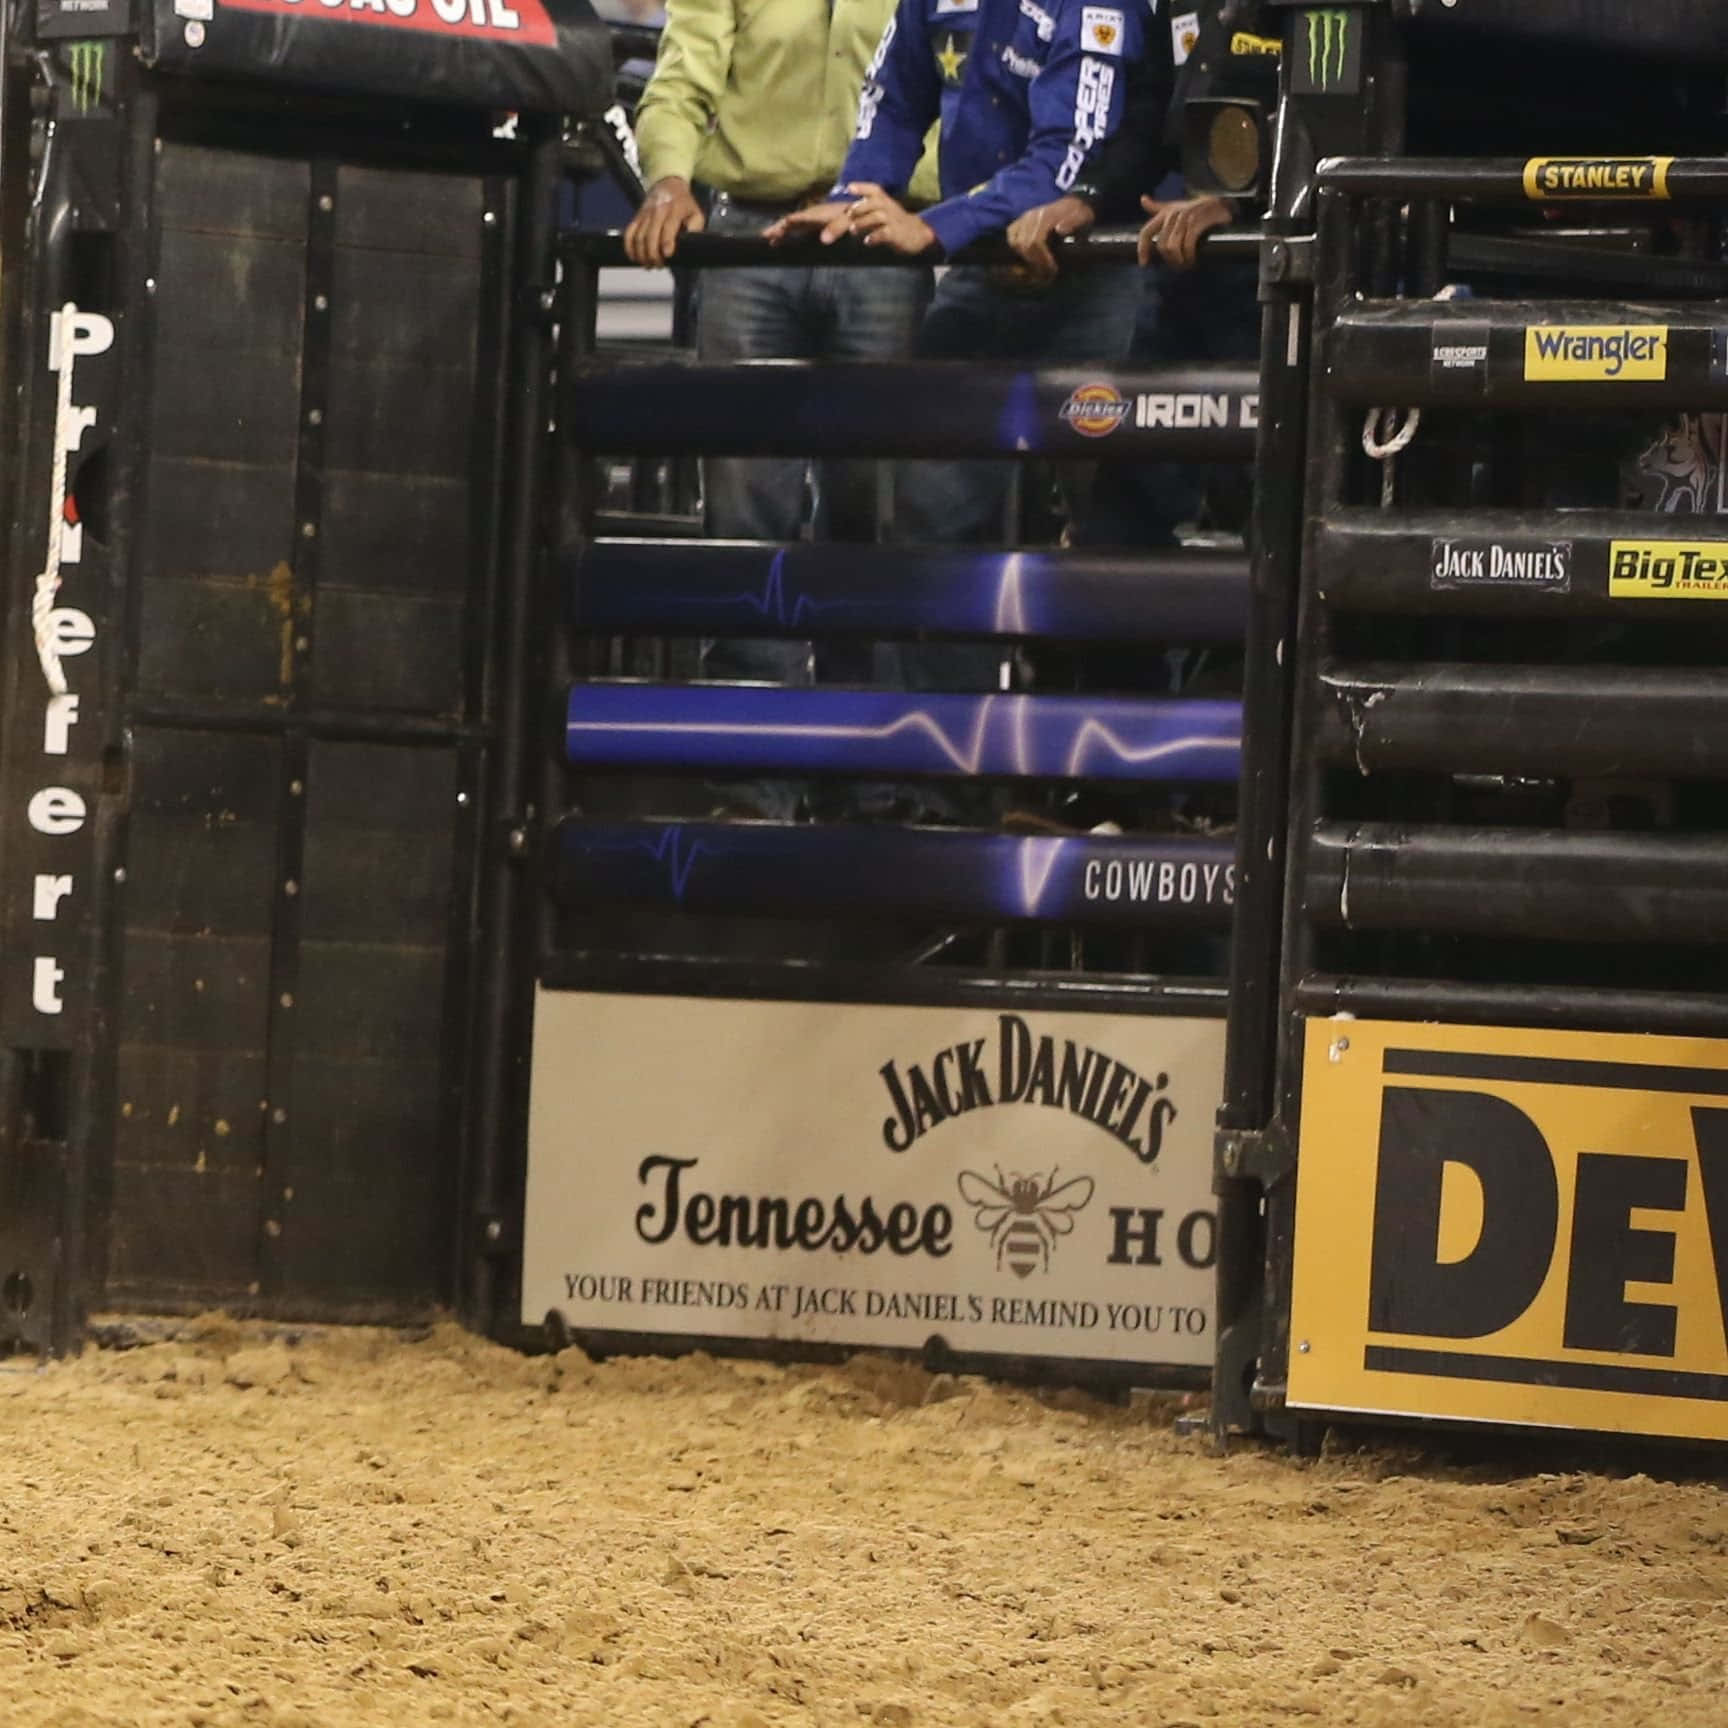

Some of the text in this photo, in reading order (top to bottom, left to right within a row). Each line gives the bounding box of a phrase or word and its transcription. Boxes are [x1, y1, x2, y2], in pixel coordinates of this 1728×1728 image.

[1543, 166, 1646, 189] STANLEY
[1534, 329, 1661, 375] Wrangler
[1136, 394, 1229, 428] IRON
[1435, 543, 1565, 580] JACK DANIEL'S
[880, 1014, 1178, 1165] JACK DANIEL'S
[635, 1154, 954, 1259] Tennessee
[1368, 1085, 1728, 1359] DE
[564, 1273, 1207, 1336] YOUR FRIENDS AT JACK DANIEL'S REMIND YOU TO
